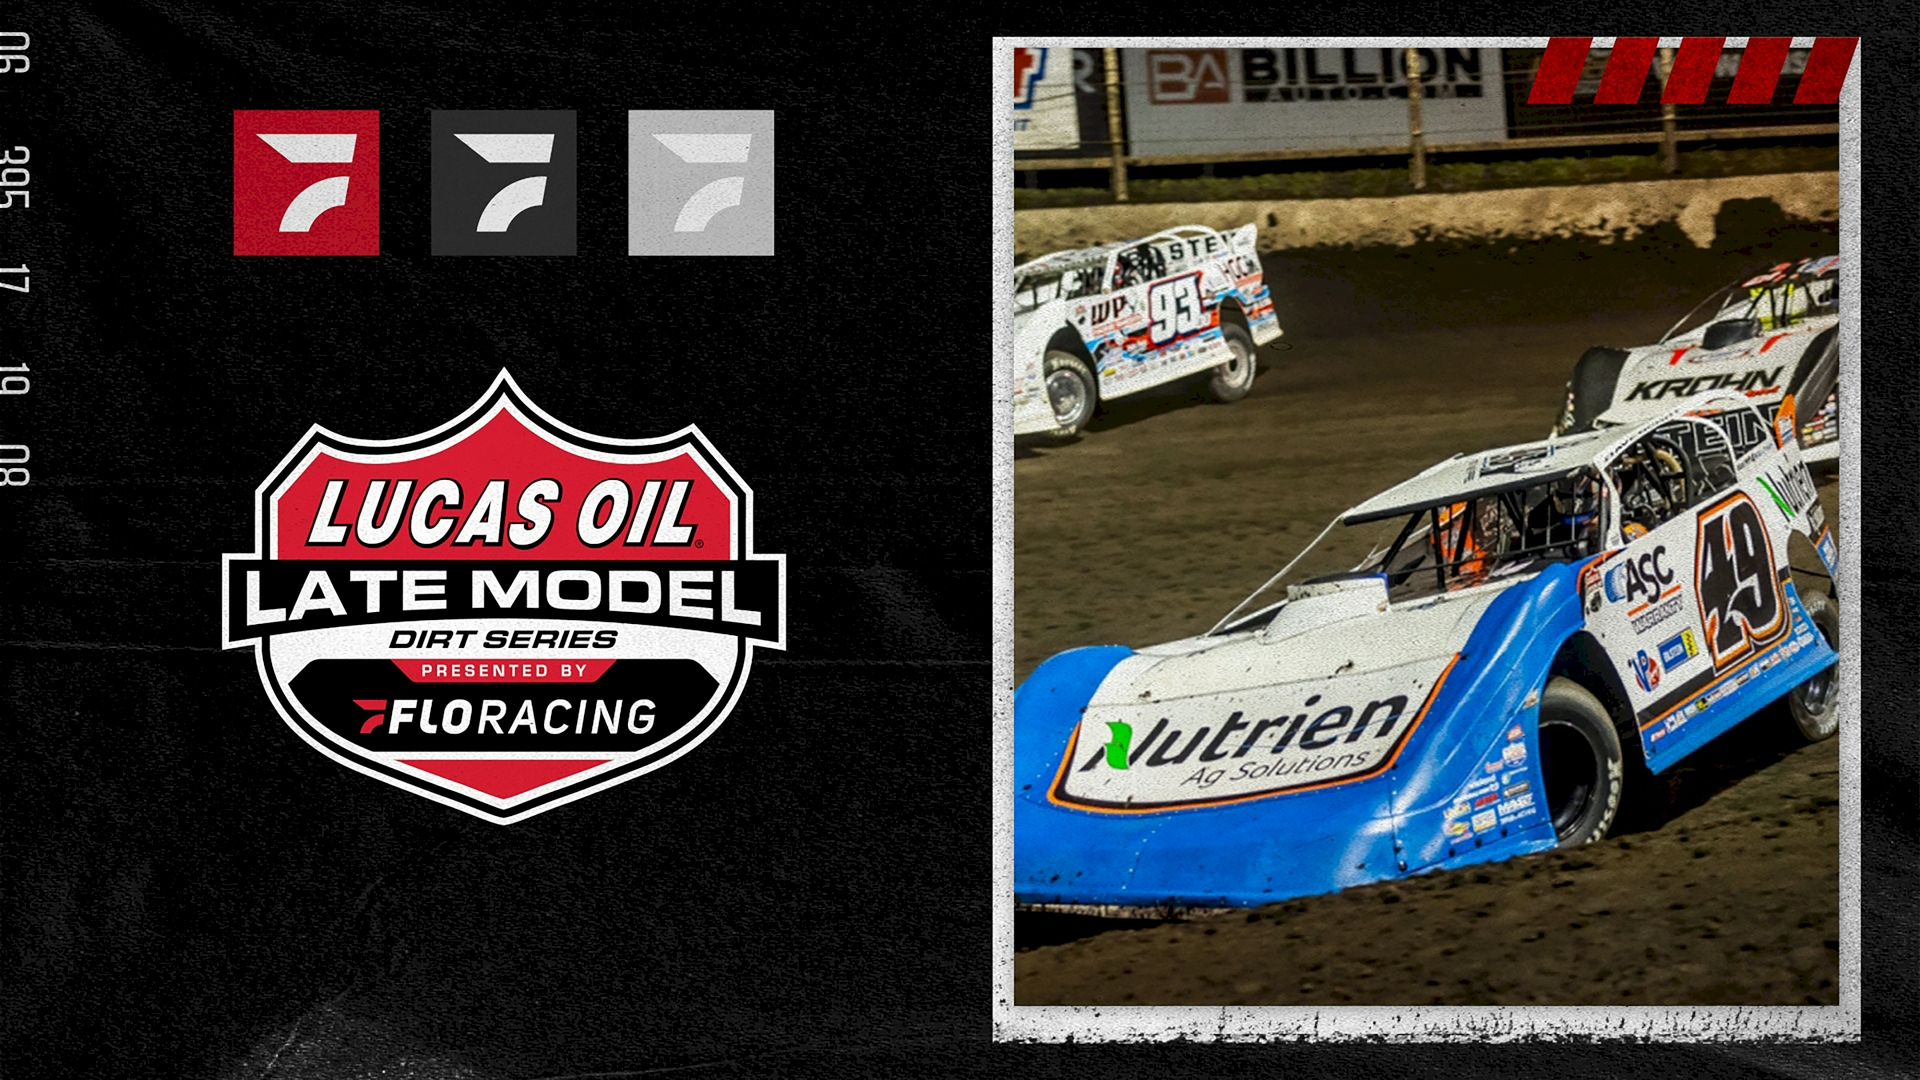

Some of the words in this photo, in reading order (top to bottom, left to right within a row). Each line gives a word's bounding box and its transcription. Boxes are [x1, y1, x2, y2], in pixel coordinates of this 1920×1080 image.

[1243, 48, 1483, 86] BILLION
[1150, 276, 1206, 347] 93
[1625, 366, 1785, 401] KROHN
[1626, 545, 1674, 604] ASC
[1701, 501, 1778, 653] 49
[1079, 694, 1409, 772] Nutrien
[1180, 766, 1225, 789] Ag
[1230, 751, 1371, 781] Solutions
